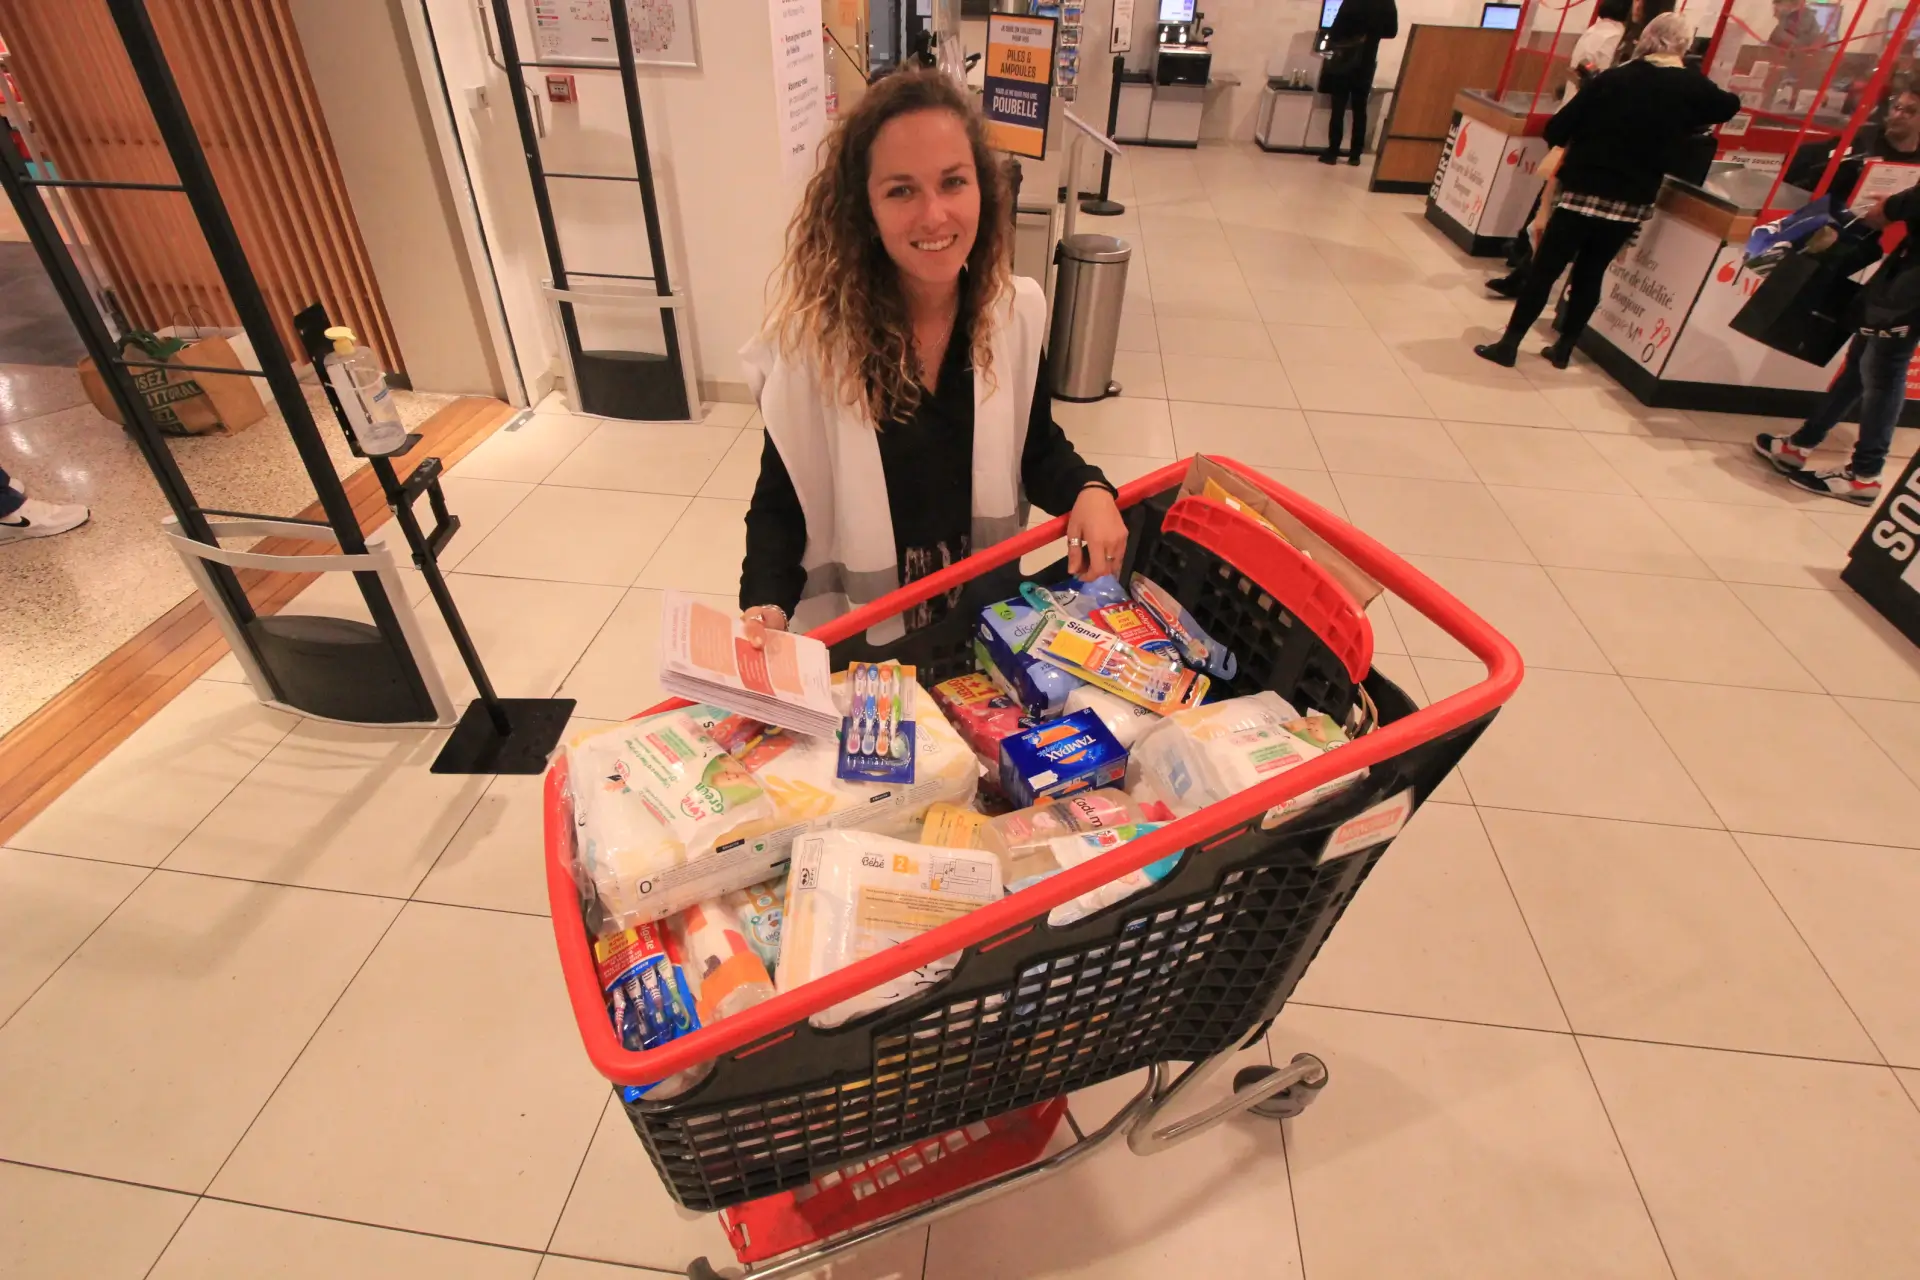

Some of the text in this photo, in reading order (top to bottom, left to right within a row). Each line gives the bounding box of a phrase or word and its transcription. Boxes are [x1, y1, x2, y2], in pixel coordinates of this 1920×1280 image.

[1007, 49, 1032, 63] PILES &
[1000, 62, 1037, 78] AMPOULES
[992, 96, 1039, 118] POUBELLE
[1429, 124, 1460, 200] SORTIE
[1611, 283, 1646, 318] Bonjour
[1067, 620, 1101, 640] Signal
[1135, 608, 1159, 636] Colgate
[946, 679, 977, 699] OFFERT
[1046, 734, 1097, 762] TAMPAX
[694, 781, 725, 815] Green
[861, 856, 885, 869] Bébé
[894, 855, 906, 870] 2
